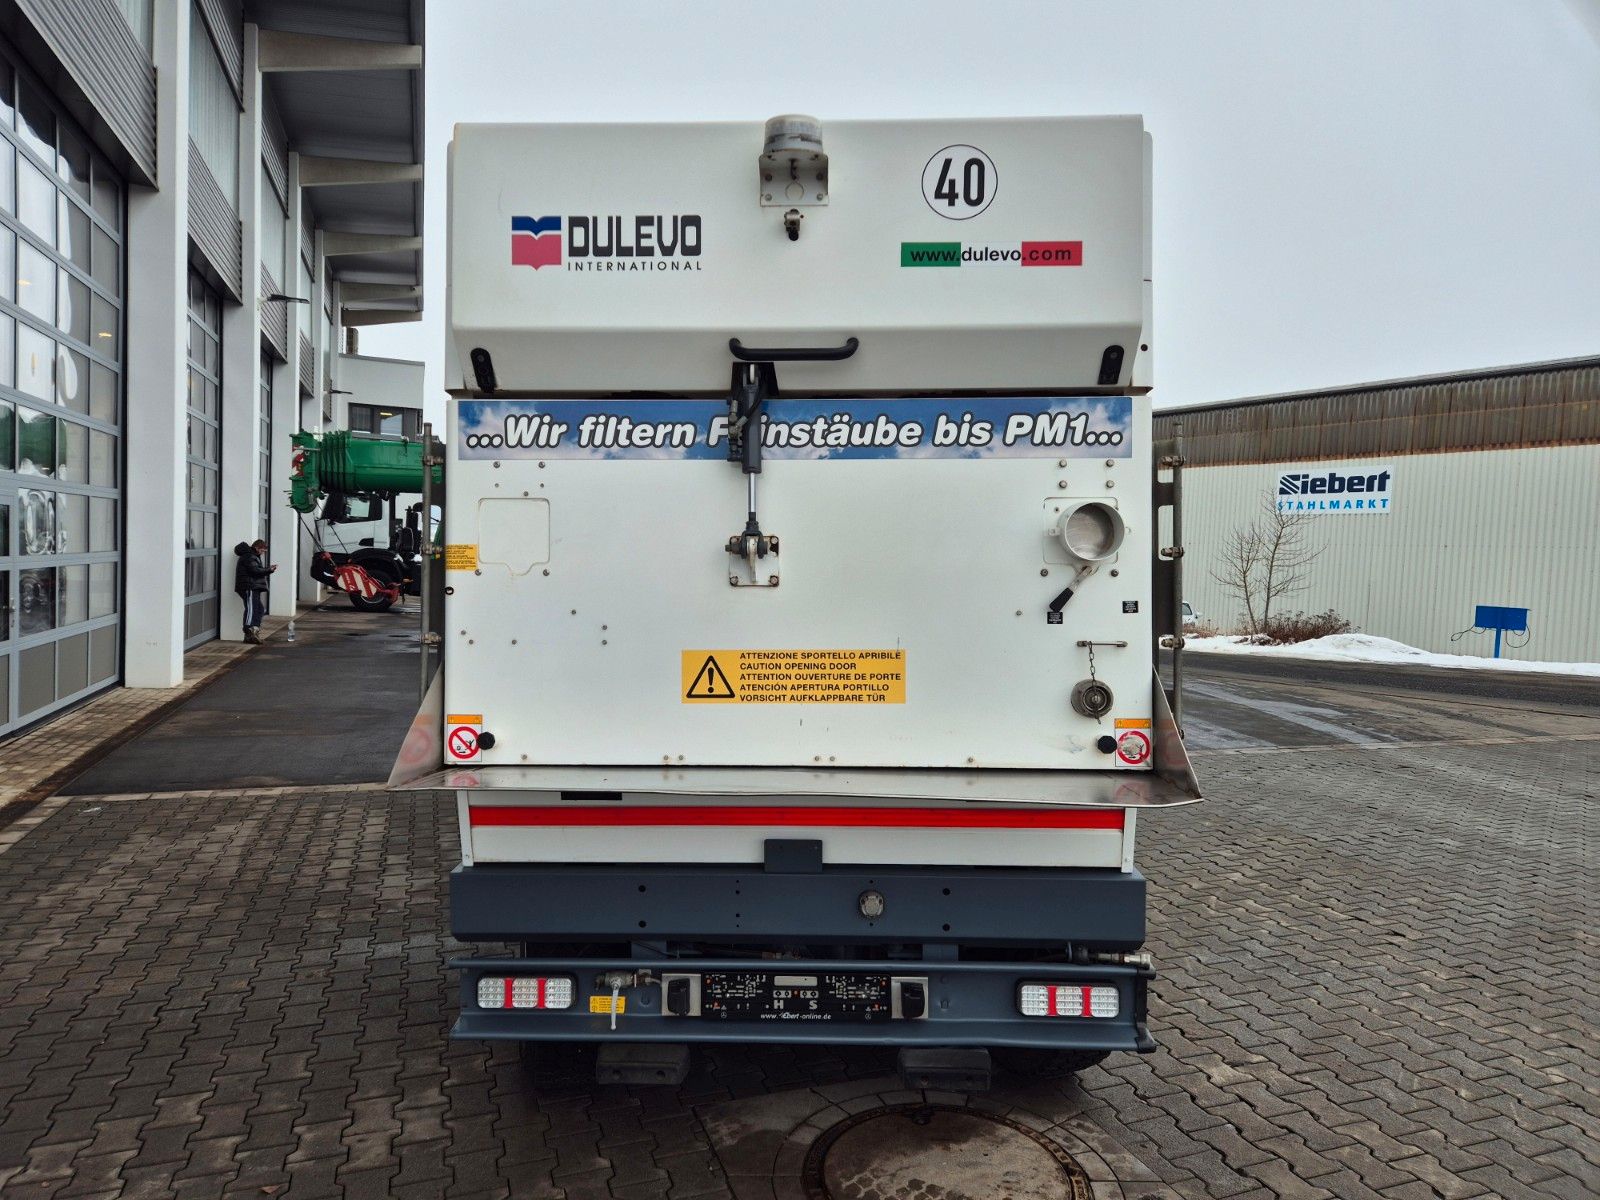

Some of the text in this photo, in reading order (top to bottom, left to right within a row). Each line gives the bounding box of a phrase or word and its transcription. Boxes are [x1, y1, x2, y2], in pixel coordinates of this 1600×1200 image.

[934, 158, 986, 207] 40
[568, 215, 702, 257] DULEVO
[911, 247, 1072, 262] www.dulevo.com
[568, 261, 702, 271] INTERNATIONAL
[578, 413, 697, 449] filtern
[707, 412, 924, 448] Finstäube
[931, 411, 995, 447] bis
[1279, 471, 1390, 495] Siebert
[1278, 498, 1388, 511] STAHLMARKT
[740, 662, 857, 670] CAUTION OPENING DOOR
[740, 682, 788, 691] ATENCIÓN
[740, 692, 886, 702] VORSICHT AUFKLAPPBARE TÜR
